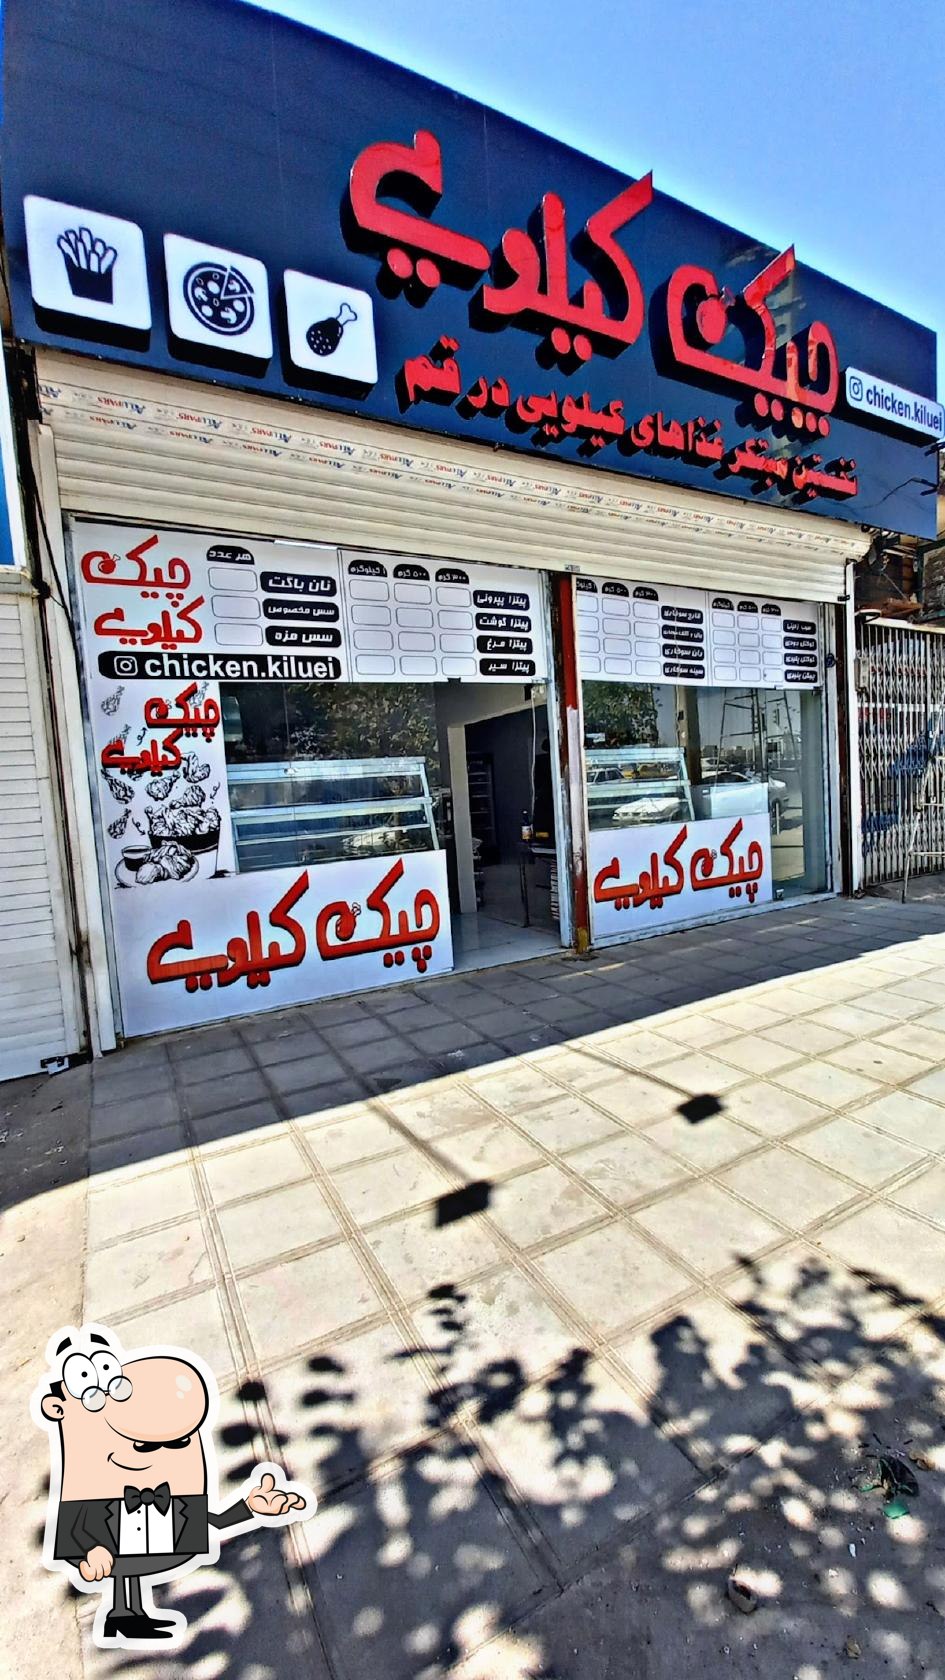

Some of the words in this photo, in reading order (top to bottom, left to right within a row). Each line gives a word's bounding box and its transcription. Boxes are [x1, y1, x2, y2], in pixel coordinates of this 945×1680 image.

[404, 335, 461, 402] قم
[466, 376, 510, 409] در
[866, 385, 942, 432] chicken.kiluei
[516, 391, 625, 448] کیلویی
[630, 410, 724, 461] غذاهای
[728, 438, 788, 487] مبتکر
[792, 454, 858, 498] نخستین
[209, 550, 232, 559] عدد
[235, 552, 252, 561] هر
[350, 565, 381, 576] کیلوگرم
[397, 569, 411, 578] گرم
[268, 576, 304, 592] باگت
[437, 573, 451, 582] گرم
[308, 579, 331, 592] نان
[476, 593, 505, 607] پپرونی
[508, 594, 527, 608] پیتزا
[268, 605, 310, 615] مخصوص
[312, 607, 335, 617] سس
[479, 615, 507, 628] گوشت
[510, 618, 529, 631] پیتزا
[275, 630, 298, 642] مزه
[302, 633, 333, 643] سس
[486, 638, 505, 649] مرغ
[509, 638, 528, 650] پیتزا
[144, 655, 335, 678] chicken.kiluei
[488, 662, 508, 672] سیر
[511, 661, 530, 672] پیتزا
